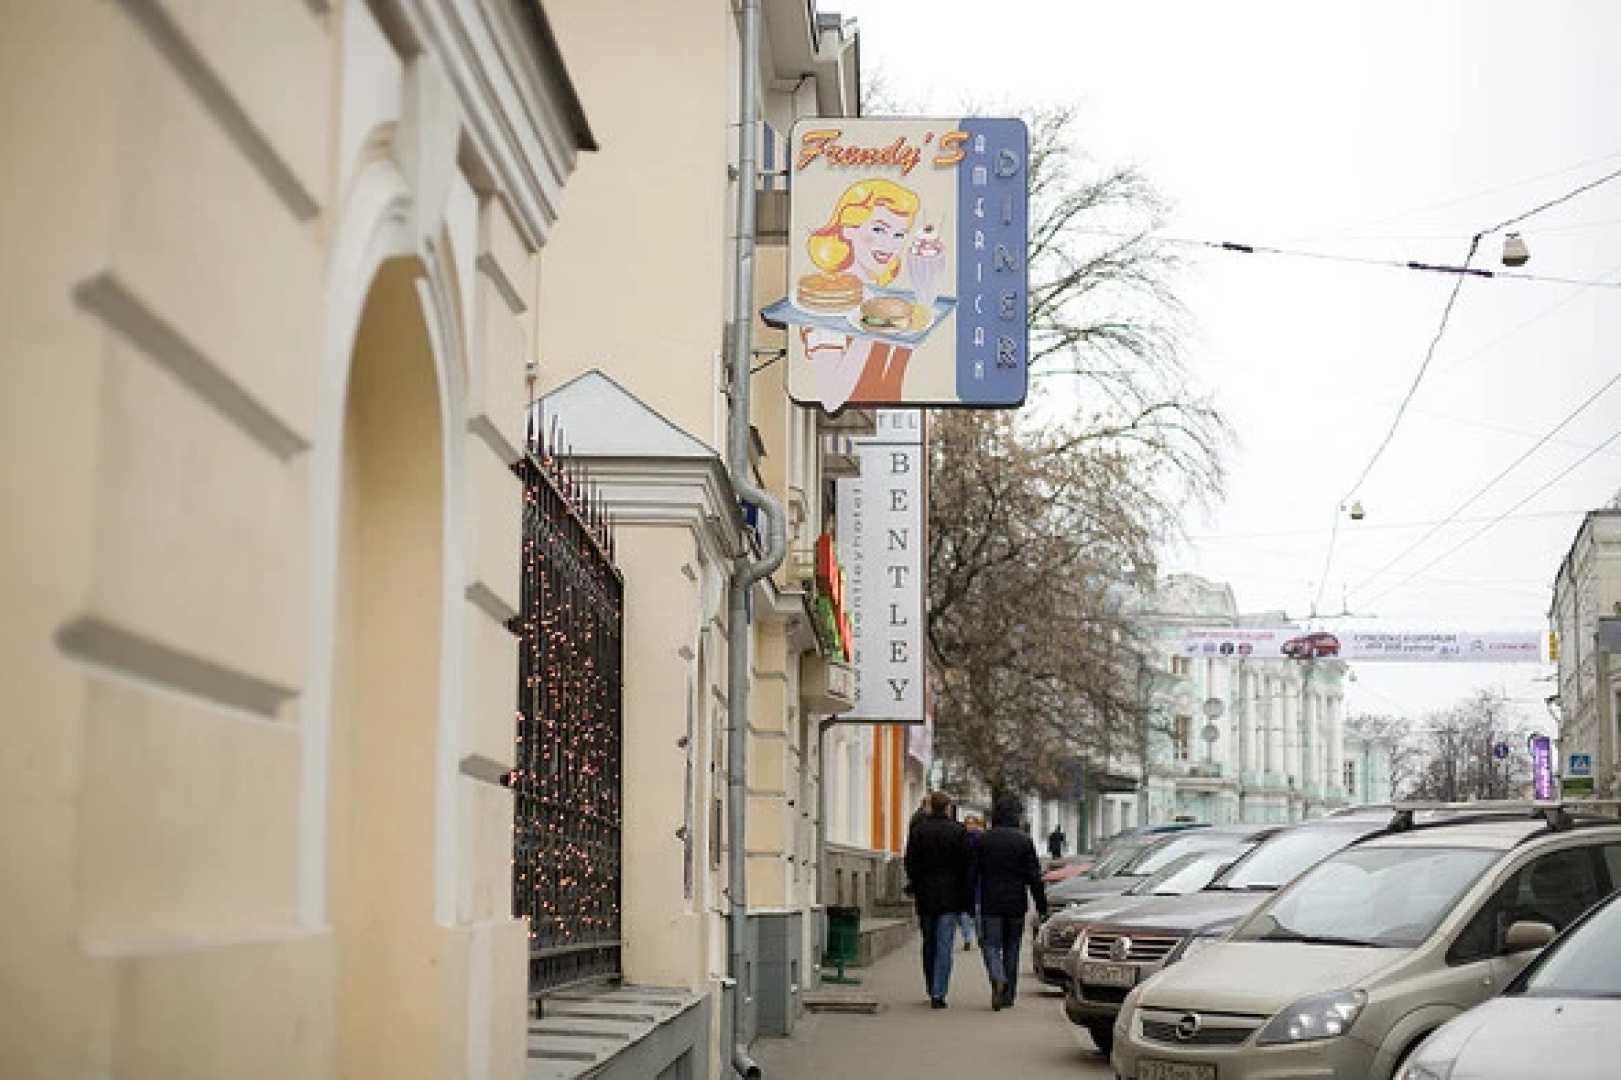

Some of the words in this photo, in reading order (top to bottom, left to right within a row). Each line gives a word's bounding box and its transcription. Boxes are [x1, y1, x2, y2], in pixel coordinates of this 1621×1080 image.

[994, 149, 1019, 370] DINER
[877, 414, 918, 429] TEL
[887, 452, 910, 702] BENTLEY
